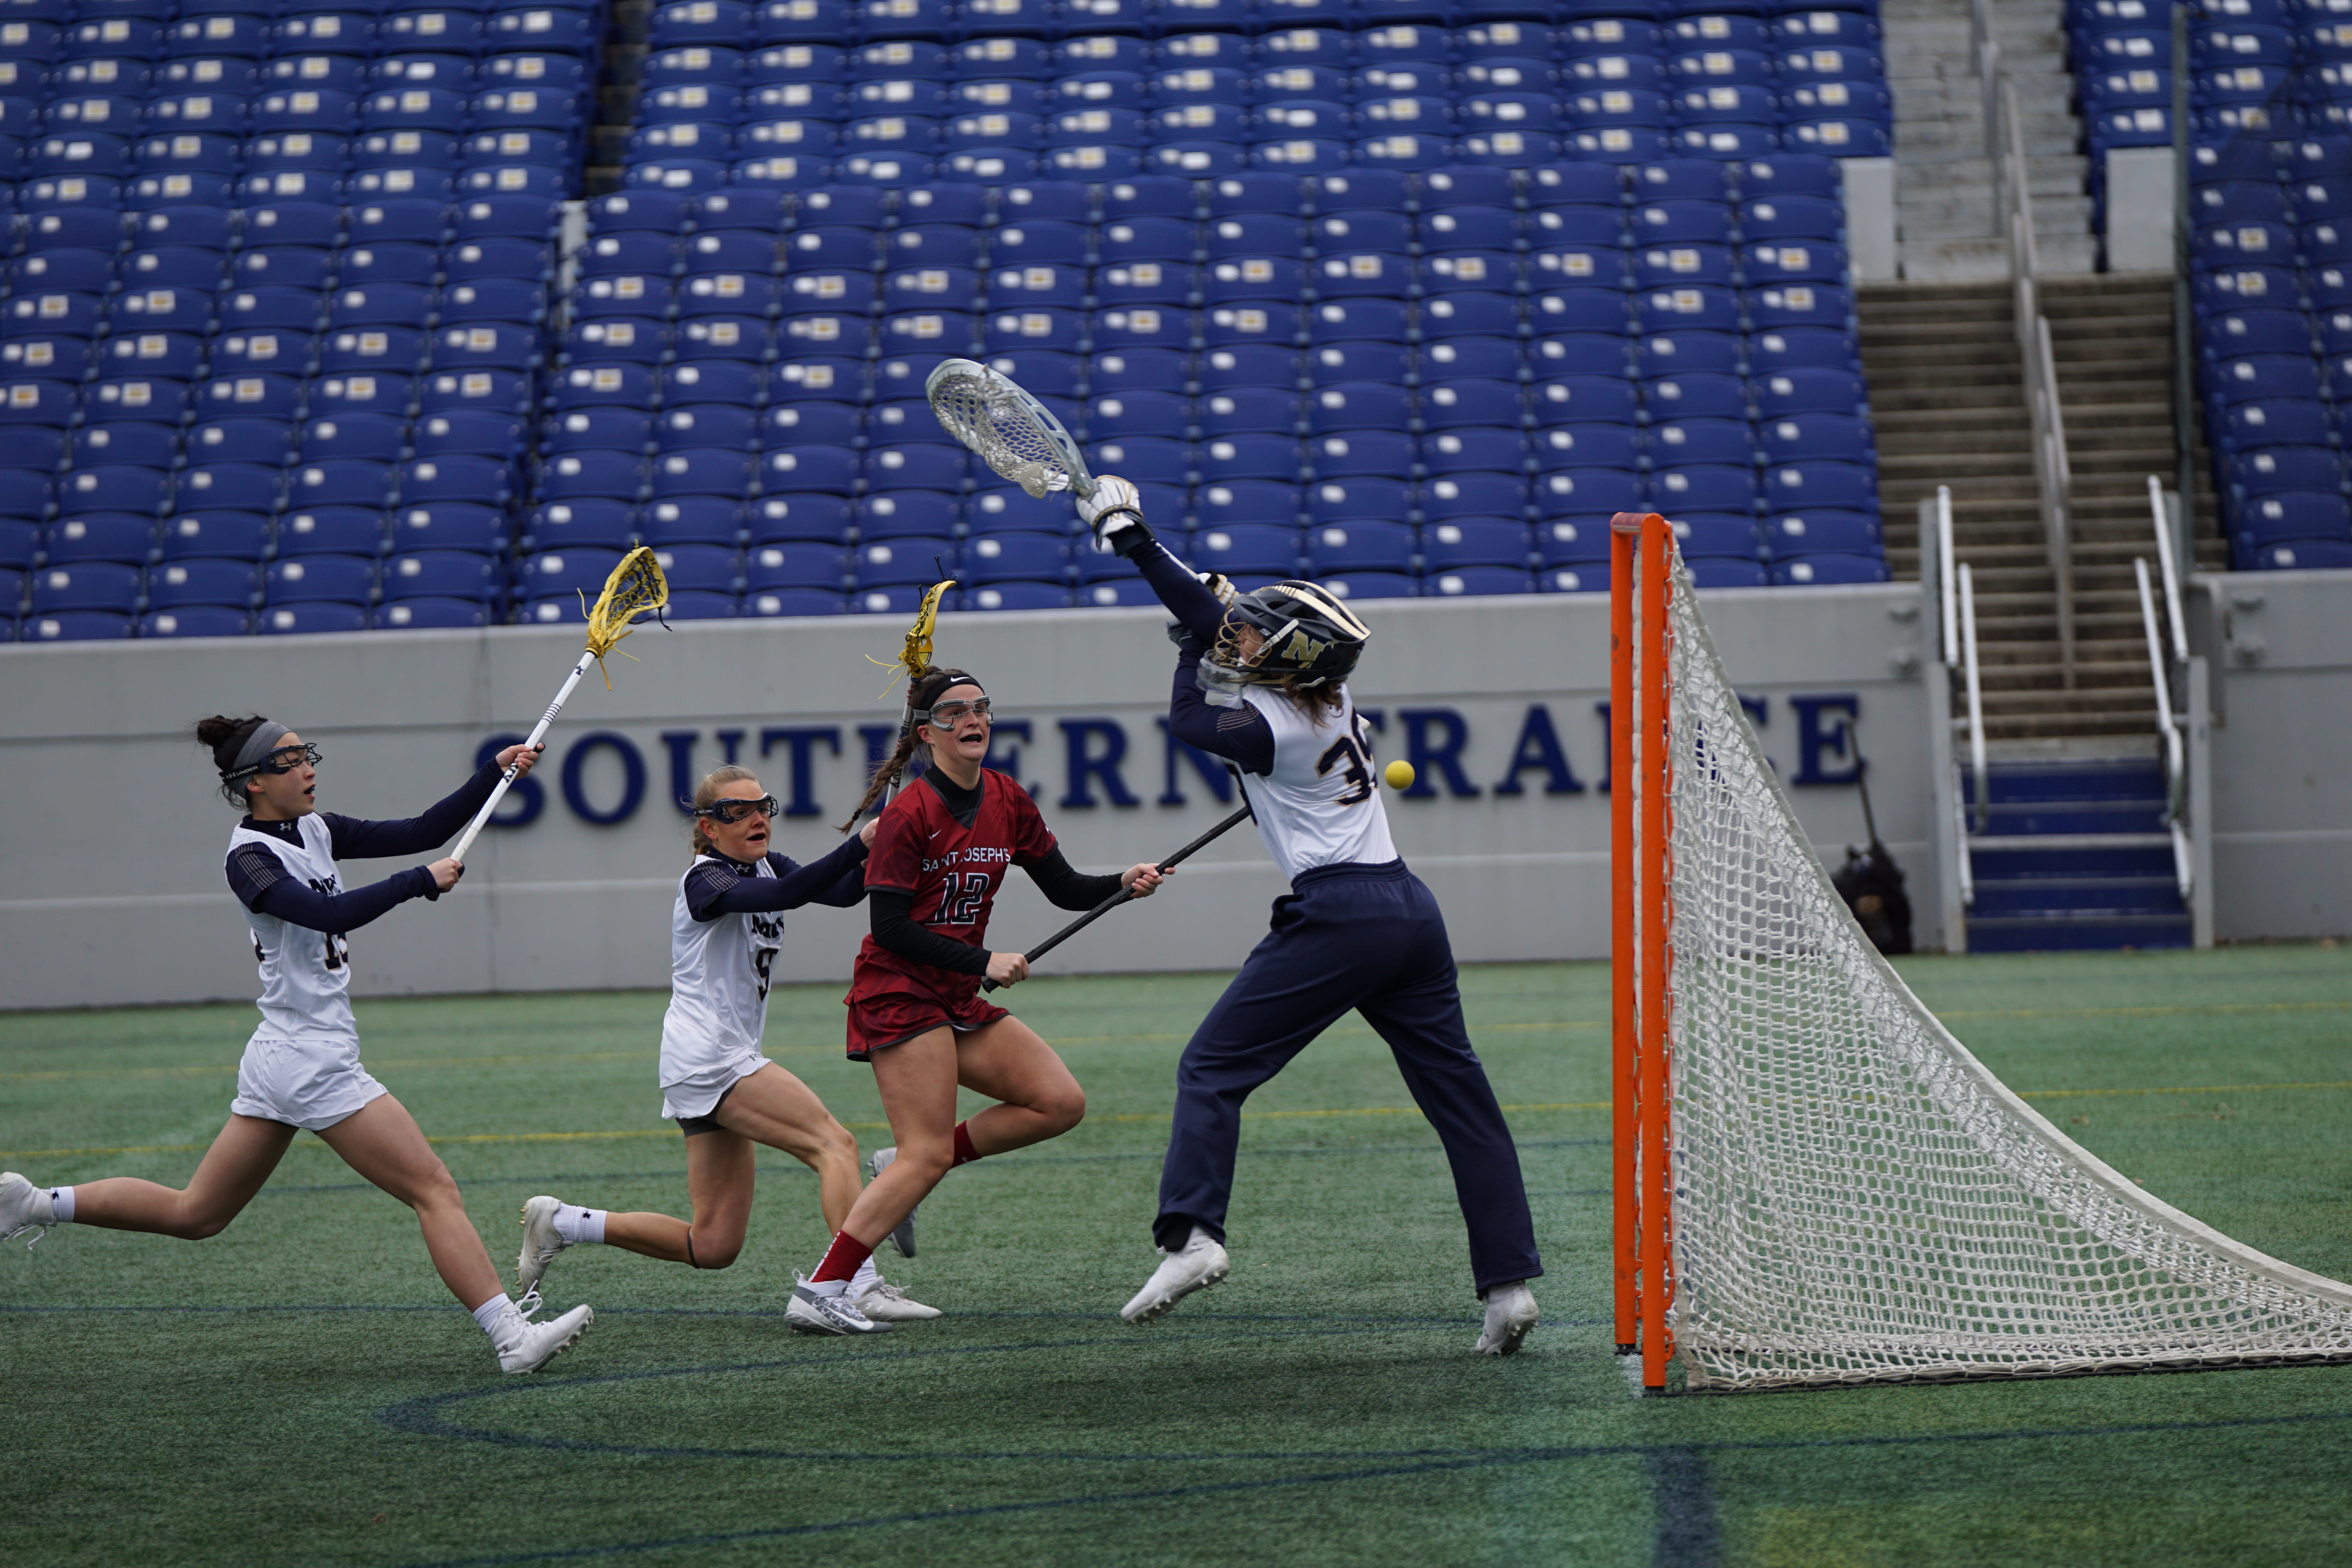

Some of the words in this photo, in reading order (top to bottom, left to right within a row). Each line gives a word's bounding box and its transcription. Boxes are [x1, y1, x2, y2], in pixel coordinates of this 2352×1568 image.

[1281, 629, 1325, 661] N
[1314, 706, 1379, 808] 3
[1356, 695, 1867, 798] RAE
[236, 765, 259, 776] UNDER
[922, 851, 959, 872] SANT
[960, 847, 1011, 862] OSEPH'S
[925, 872, 990, 926] 12
[325, 932, 348, 971] 1
